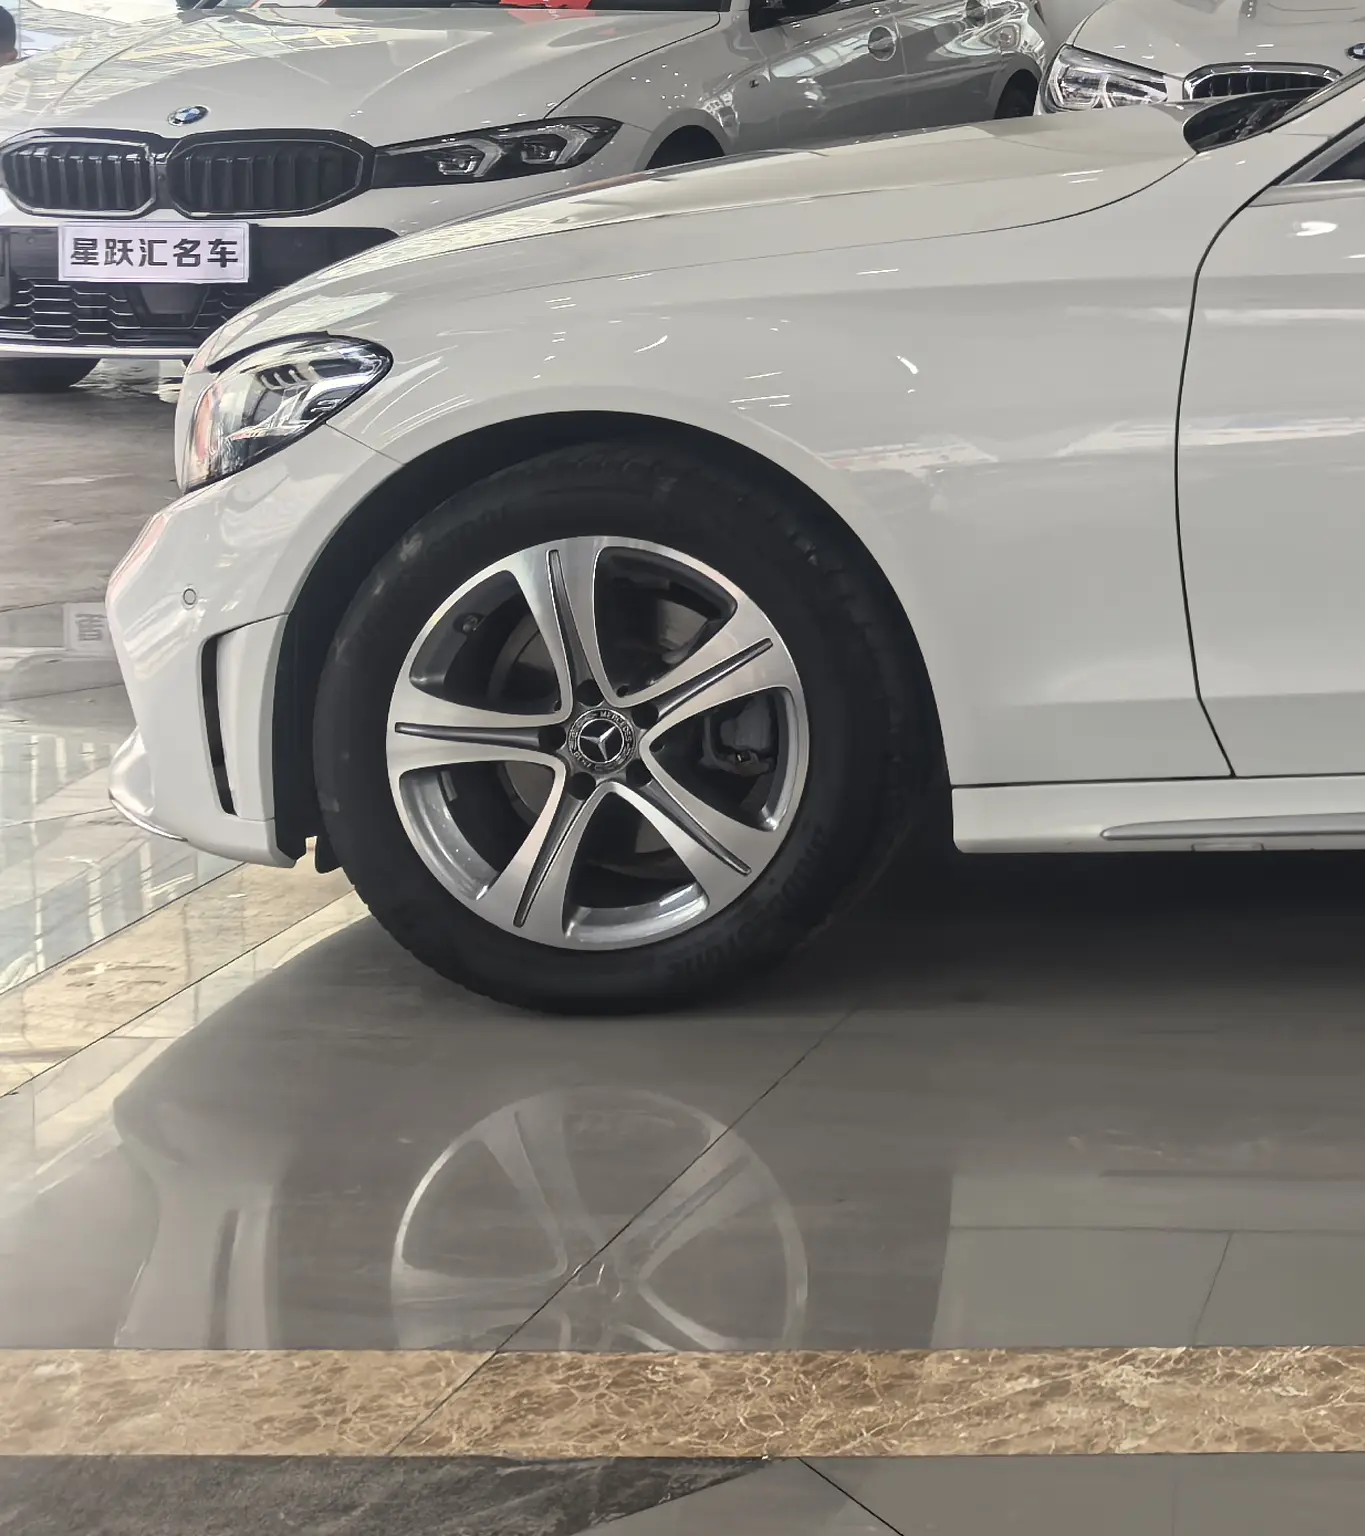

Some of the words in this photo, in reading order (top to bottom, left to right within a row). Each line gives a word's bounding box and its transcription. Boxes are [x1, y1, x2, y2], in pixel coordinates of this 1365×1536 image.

[70, 237, 239, 268] 星跃汇名车
